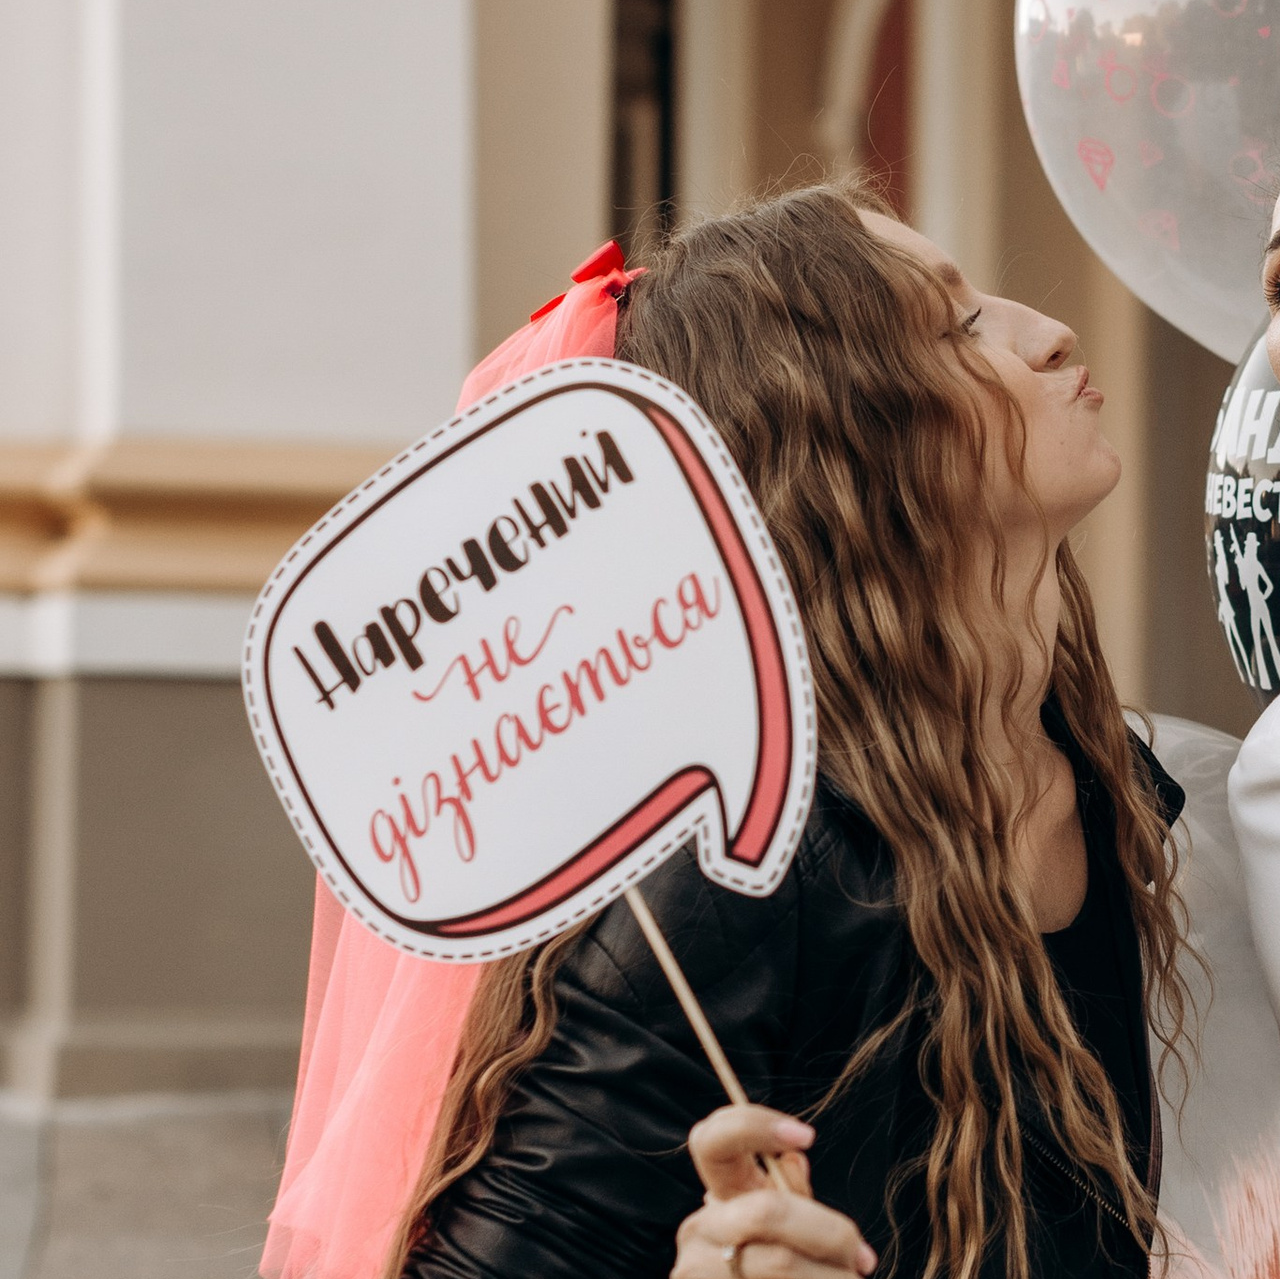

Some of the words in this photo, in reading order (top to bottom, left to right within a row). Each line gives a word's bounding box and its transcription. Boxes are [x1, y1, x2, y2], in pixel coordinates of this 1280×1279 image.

[293, 430, 635, 710] Наречений
[413, 604, 575, 701] не
[369, 572, 722, 903] дізнається
